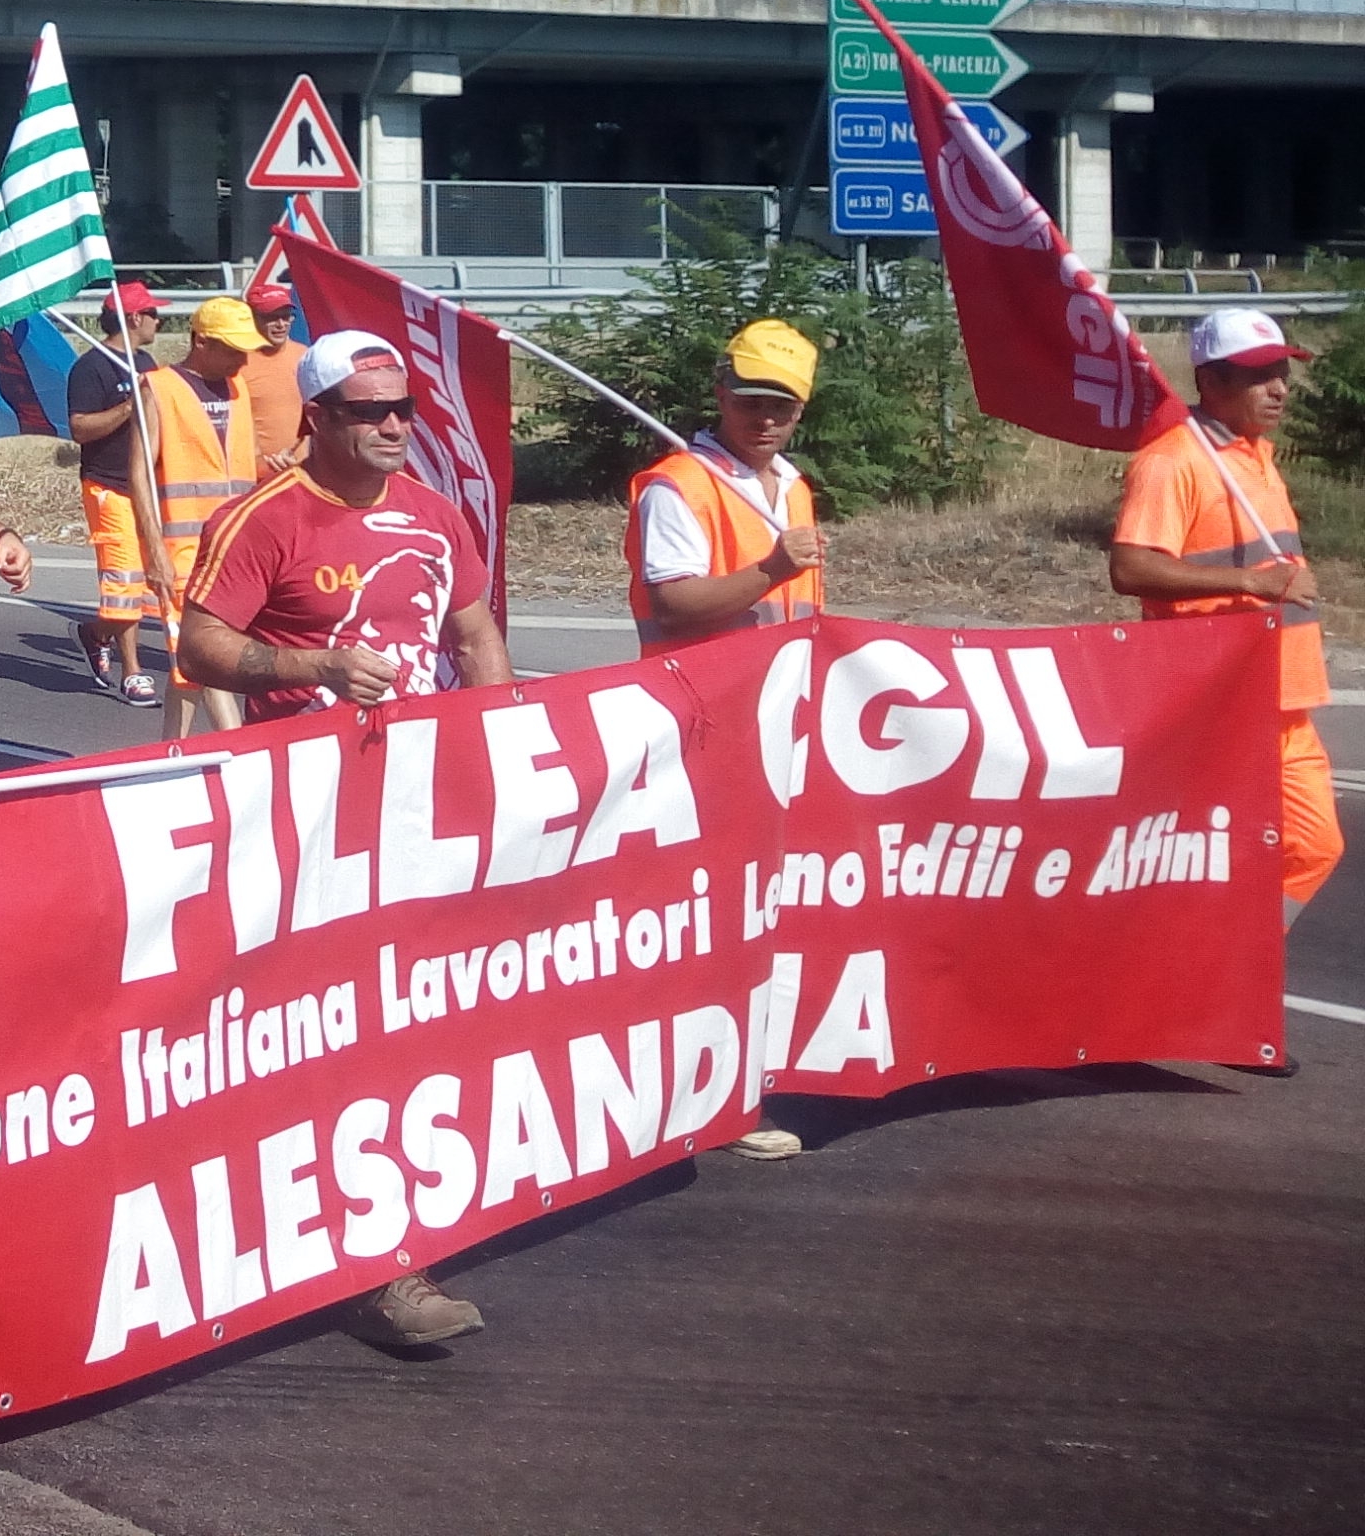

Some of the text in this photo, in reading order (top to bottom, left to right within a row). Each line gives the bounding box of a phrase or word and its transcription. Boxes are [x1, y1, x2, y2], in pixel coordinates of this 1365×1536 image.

[314, 563, 366, 594] 04
[100, 637, 1125, 984] FILLEA CGIL
[119, 978, 357, 1129] Italiana
[379, 866, 711, 1035] Lavoratori
[878, 822, 1022, 901] Edili
[1035, 841, 1072, 901] e
[1085, 805, 1233, 898] Affini
